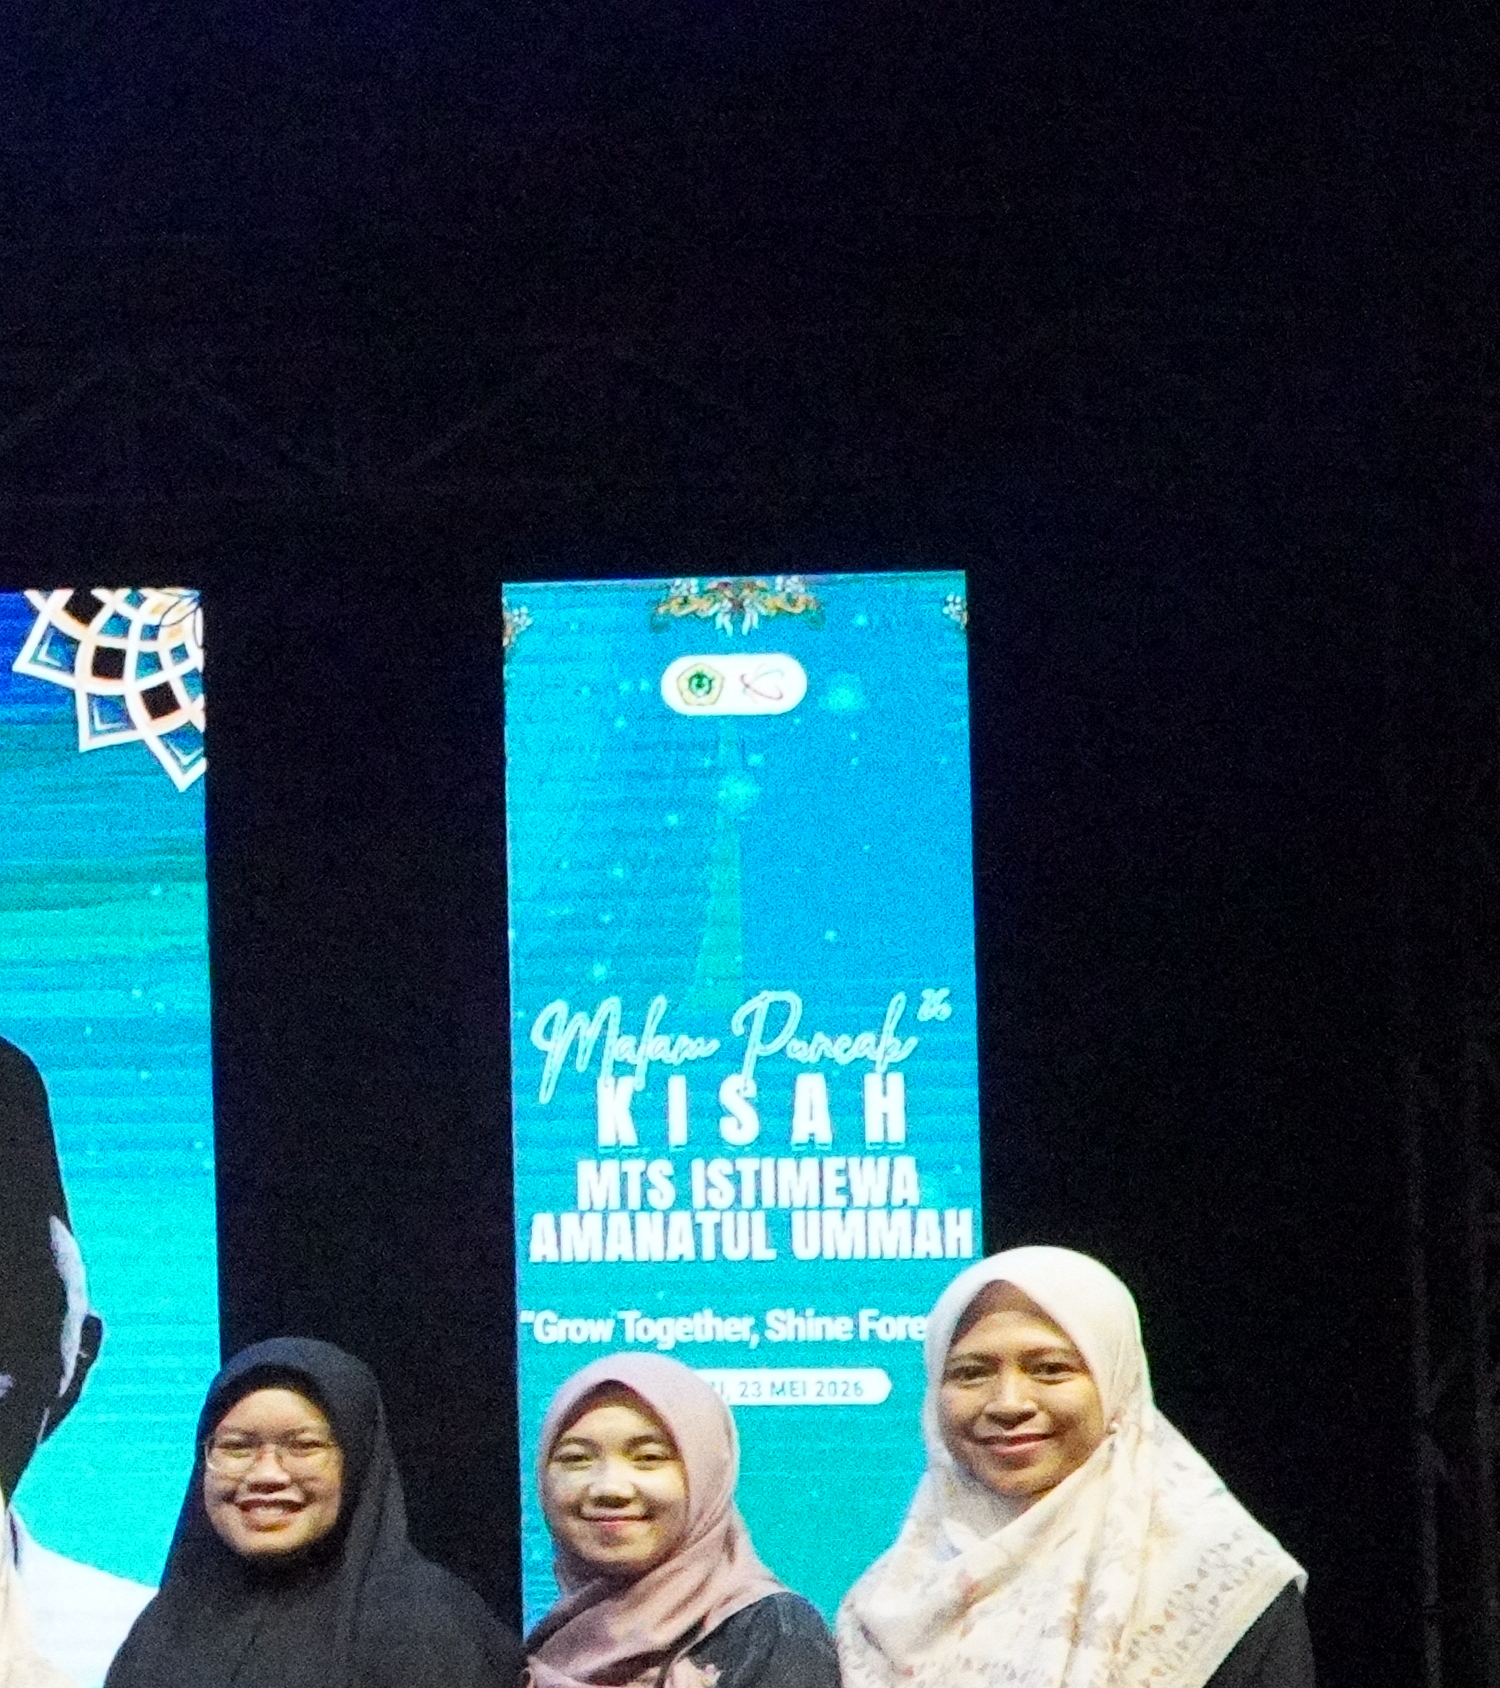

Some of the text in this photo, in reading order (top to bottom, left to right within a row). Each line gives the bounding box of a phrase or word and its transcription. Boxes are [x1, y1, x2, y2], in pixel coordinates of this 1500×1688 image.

[597, 1071, 907, 1148] KISAH
[576, 1154, 921, 1212] MTS ISTIMEWA
[528, 1207, 975, 1264] AMANATUL UMMAH
[617, 1308, 760, 1350] Together,
[764, 1307, 854, 1342] Shine
[858, 1308, 928, 1342] Fore
[739, 1380, 763, 1398] 23
[770, 1380, 808, 1398] MEI
[814, 1380, 865, 1398] 2026
